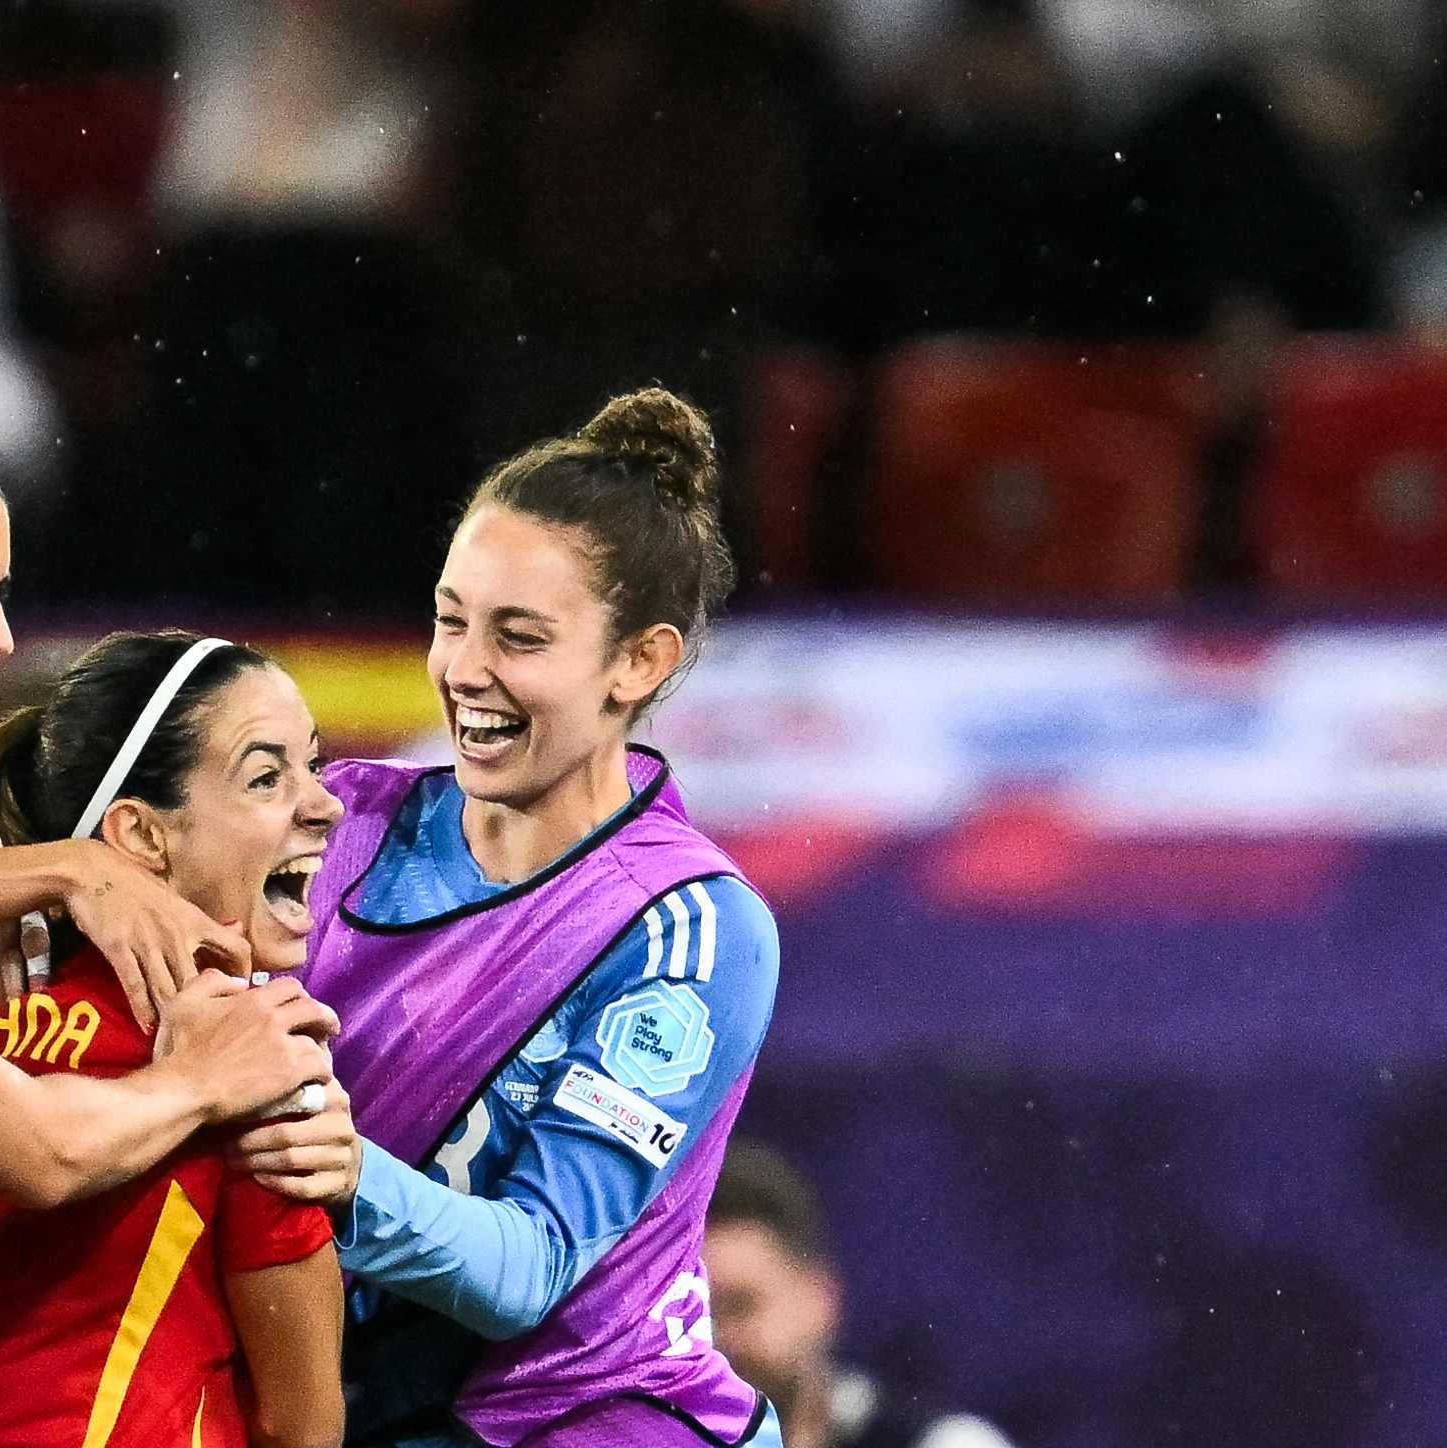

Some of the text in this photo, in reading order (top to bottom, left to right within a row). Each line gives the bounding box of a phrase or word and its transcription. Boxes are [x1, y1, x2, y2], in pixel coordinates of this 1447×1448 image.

[640, 1012, 657, 1027] We
[631, 1037, 673, 1063] Strong
[564, 1080, 650, 1133] FOUNDATION
